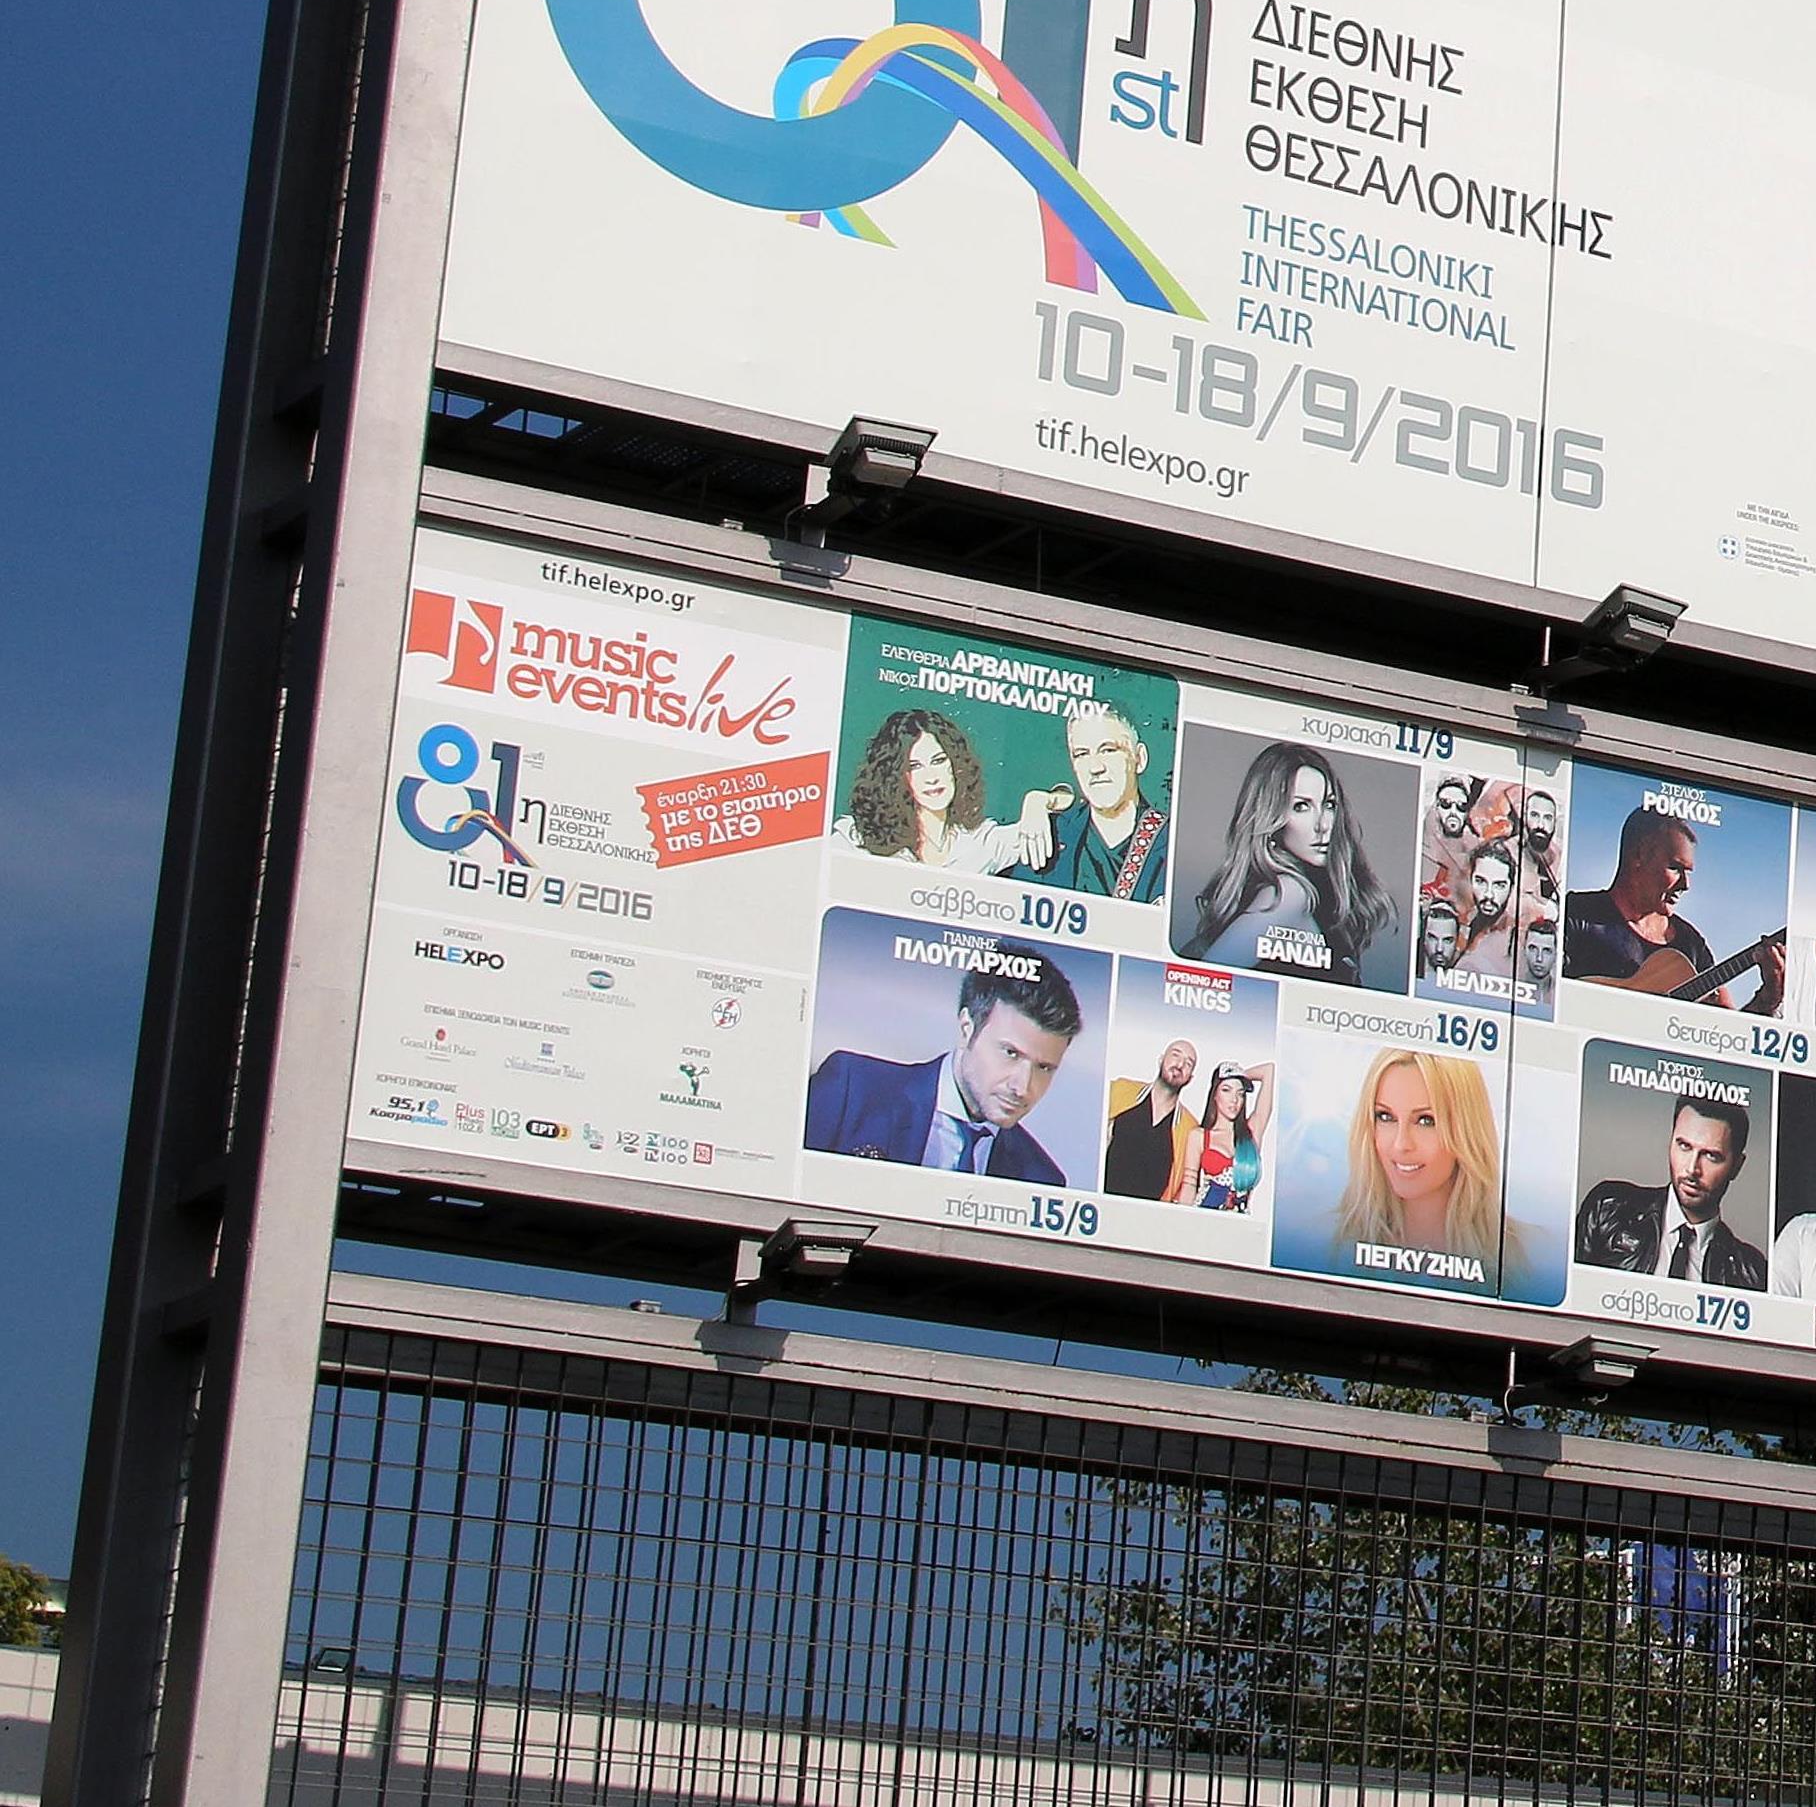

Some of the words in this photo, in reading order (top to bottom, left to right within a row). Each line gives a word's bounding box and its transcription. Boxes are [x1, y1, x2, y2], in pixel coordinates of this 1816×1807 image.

[1109, 71, 1180, 138] st
[1250, 58, 1429, 149] ΕΚΘΕΣΗ
[1245, 124, 1614, 259] ΘΕΣΣΑΛΟΝΙΚΗΣ
[1242, 204, 1494, 300] THESSALONIKI
[1237, 297, 1314, 348] FAIR
[1240, 251, 1516, 350] INTERNATIONAL
[1032, 300, 1604, 510] 10-18/9/2016
[1034, 417, 1250, 498] tif.helexpo.gr
[541, 561, 696, 611] tif.helexpo.gr
[510, 620, 678, 684] music
[881, 644, 950, 669] ΕΛΕΥΘΕΡΙΑ
[950, 650, 1094, 698] ΑΡΒΑΝΙΤΑΚΗ
[506, 662, 690, 728] events
[687, 654, 797, 745] live
[878, 668, 918, 688] ΝΙΚΟΣ
[917, 669, 1110, 719] ΠΟΡΤΟΚΑΛΟΓΛΟΥ
[1301, 715, 1390, 749] κυριακή
[1394, 722, 1454, 760] 11/9
[656, 781, 717, 808] έναρξη
[720, 772, 767, 795] 21:30
[661, 809, 692, 835] με
[694, 803, 718, 822] το
[720, 783, 821, 816] εισιτήριο
[1643, 791, 1722, 827] ΡΟΚΚΟΣ
[1660, 782, 1706, 802] ΣΤΕΛΙΟΣ
[519, 796, 547, 844] η
[549, 819, 605, 840] ΕΚΘΕΣΗ
[550, 803, 612, 825] ΔΙΕΘΝΗΣ
[666, 831, 703, 853] της
[707, 813, 762, 844] ΔΕΘ
[546, 834, 655, 865] ΘΕΣΣΑΛΟΝΙΚΗΣ
[447, 859, 654, 921] 10-18/9/2016
[910, 886, 1015, 922] σάββατο
[1020, 894, 1088, 935] 10/9
[415, 942, 505, 971] HELEXPO
[943, 931, 998, 953] ΓΙΑΝΝΗΣ
[1256, 938, 1332, 970] ΒΑΝΔΗ
[1265, 926, 1326, 945] ΔΕΣΠΟΙΝΑ
[894, 936, 1043, 983] ΠΛΟΥΤΑΡΧΟΣ
[1167, 970, 1208, 988] OPENING
[1209, 978, 1232, 991] ACT
[1165, 982, 1232, 1013] KINGS
[1306, 1004, 1433, 1042] παρασκευή
[1436, 1013, 1498, 1052] 16/9
[1667, 1016, 1747, 1052] δευτέρα
[1750, 1025, 1809, 1064] 12/9
[659, 1092, 722, 1111] ΜΑΛΑΜΑΤΙΝΑ
[1609, 1063, 1750, 1107] ΠΑΠΑΔΟΠΟΥΛΟΣ
[456, 1103, 485, 1118] Plus
[491, 1108, 521, 1128] 103
[943, 1194, 1028, 1228] πέμπτη
[1029, 1196, 1098, 1236] 15/9
[1355, 1242, 1424, 1273] ΠΕΓΚΥ
[1427, 1251, 1485, 1283] ΖΗΝΑ
[1601, 1288, 1694, 1322] σάββατο
[1695, 1294, 1751, 1332] 17/9
